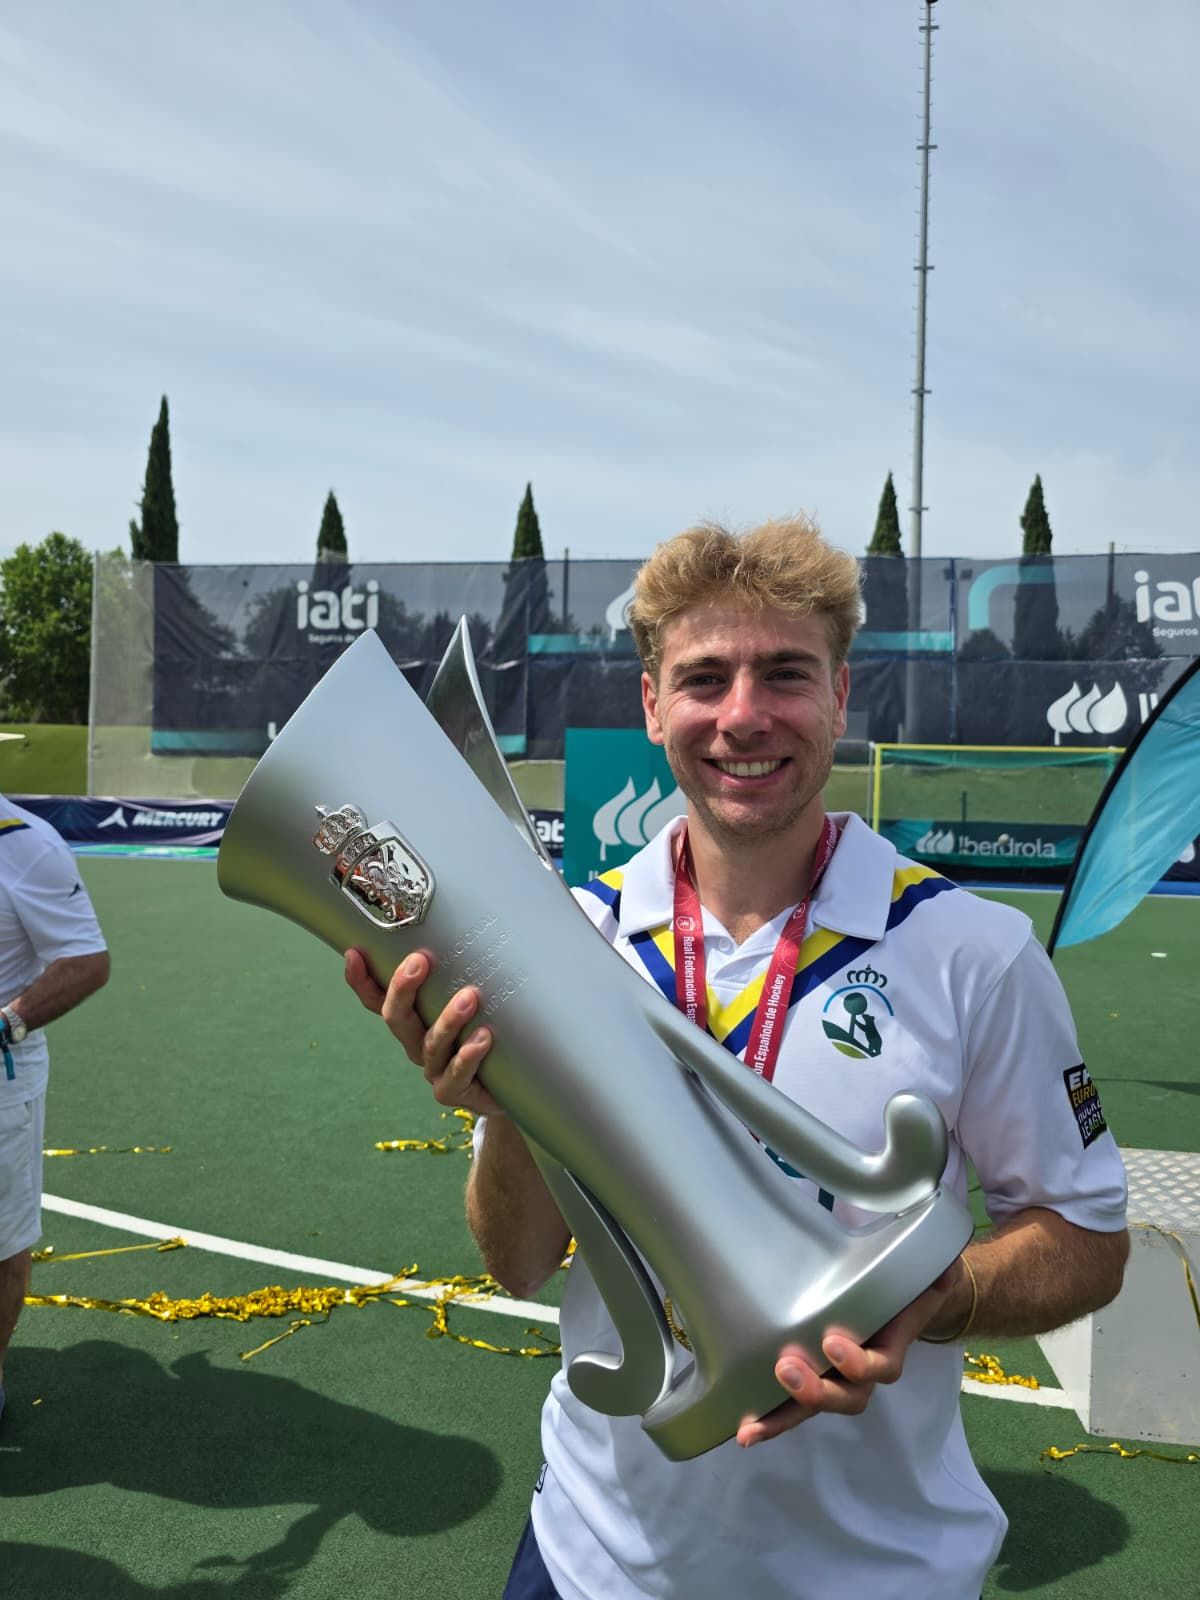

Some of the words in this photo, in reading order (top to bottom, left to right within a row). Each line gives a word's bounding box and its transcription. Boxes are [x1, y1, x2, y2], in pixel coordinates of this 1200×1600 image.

[297, 580, 379, 630] iati
[1134, 570, 1200, 623] ia
[1152, 627, 1199, 638] Seguros
[132, 811, 224, 826] MERCURY
[958, 835, 1056, 858] Iberdrola
[683, 936, 695, 955] Real
[684, 956, 697, 1002] Federación
[767, 974, 786, 1006] Hockey
[764, 1007, 778, 1019] de
[754, 1019, 774, 1063] Española
